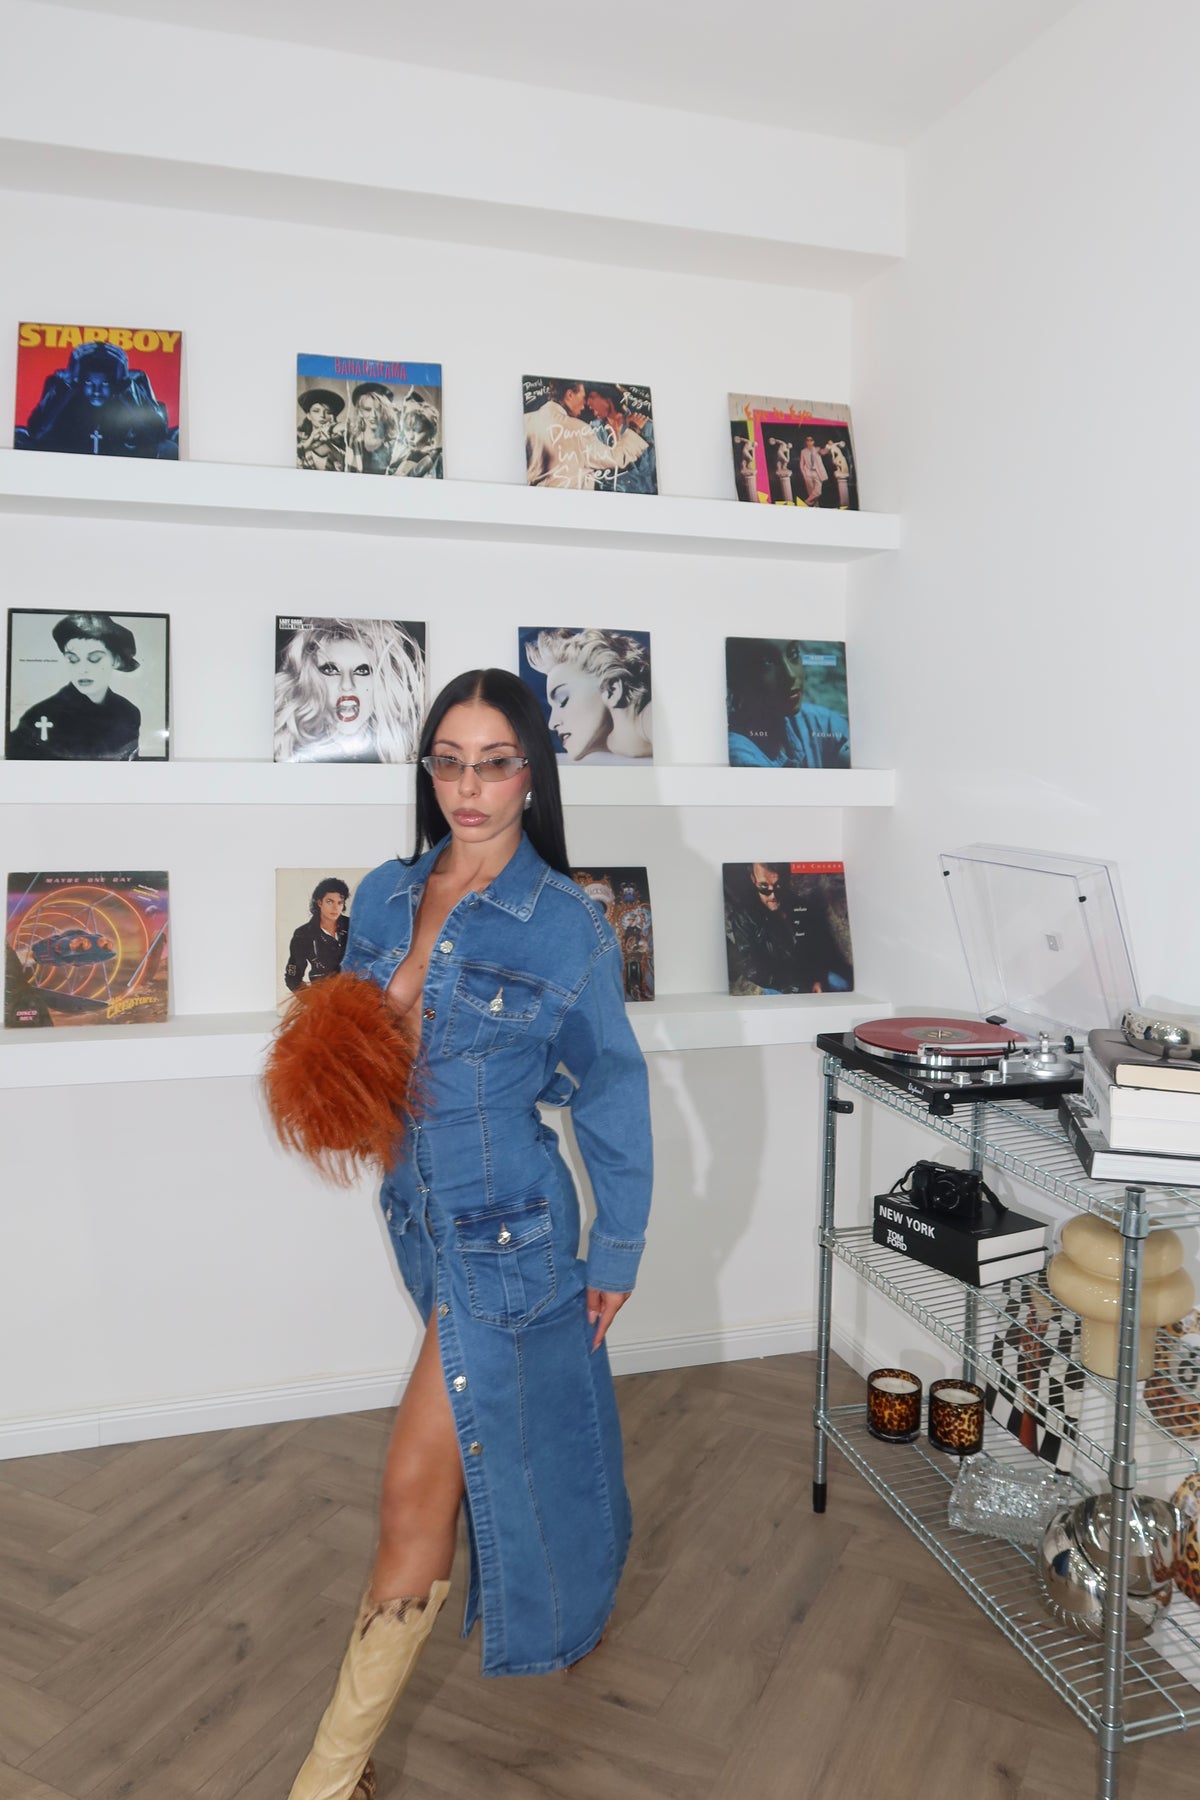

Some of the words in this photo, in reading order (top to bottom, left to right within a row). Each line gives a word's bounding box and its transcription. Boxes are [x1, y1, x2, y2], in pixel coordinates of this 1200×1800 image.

[19, 323, 181, 353] STARBOY
[335, 358, 406, 380] BANANARAMA
[547, 421, 617, 449] Dancing
[558, 445, 579, 464] in
[536, 464, 628, 491] Street
[879, 1204, 904, 1225] NEW
[906, 1215, 936, 1239] YORK
[886, 1236, 908, 1251] FORD
[887, 1228, 904, 1243] TOM
